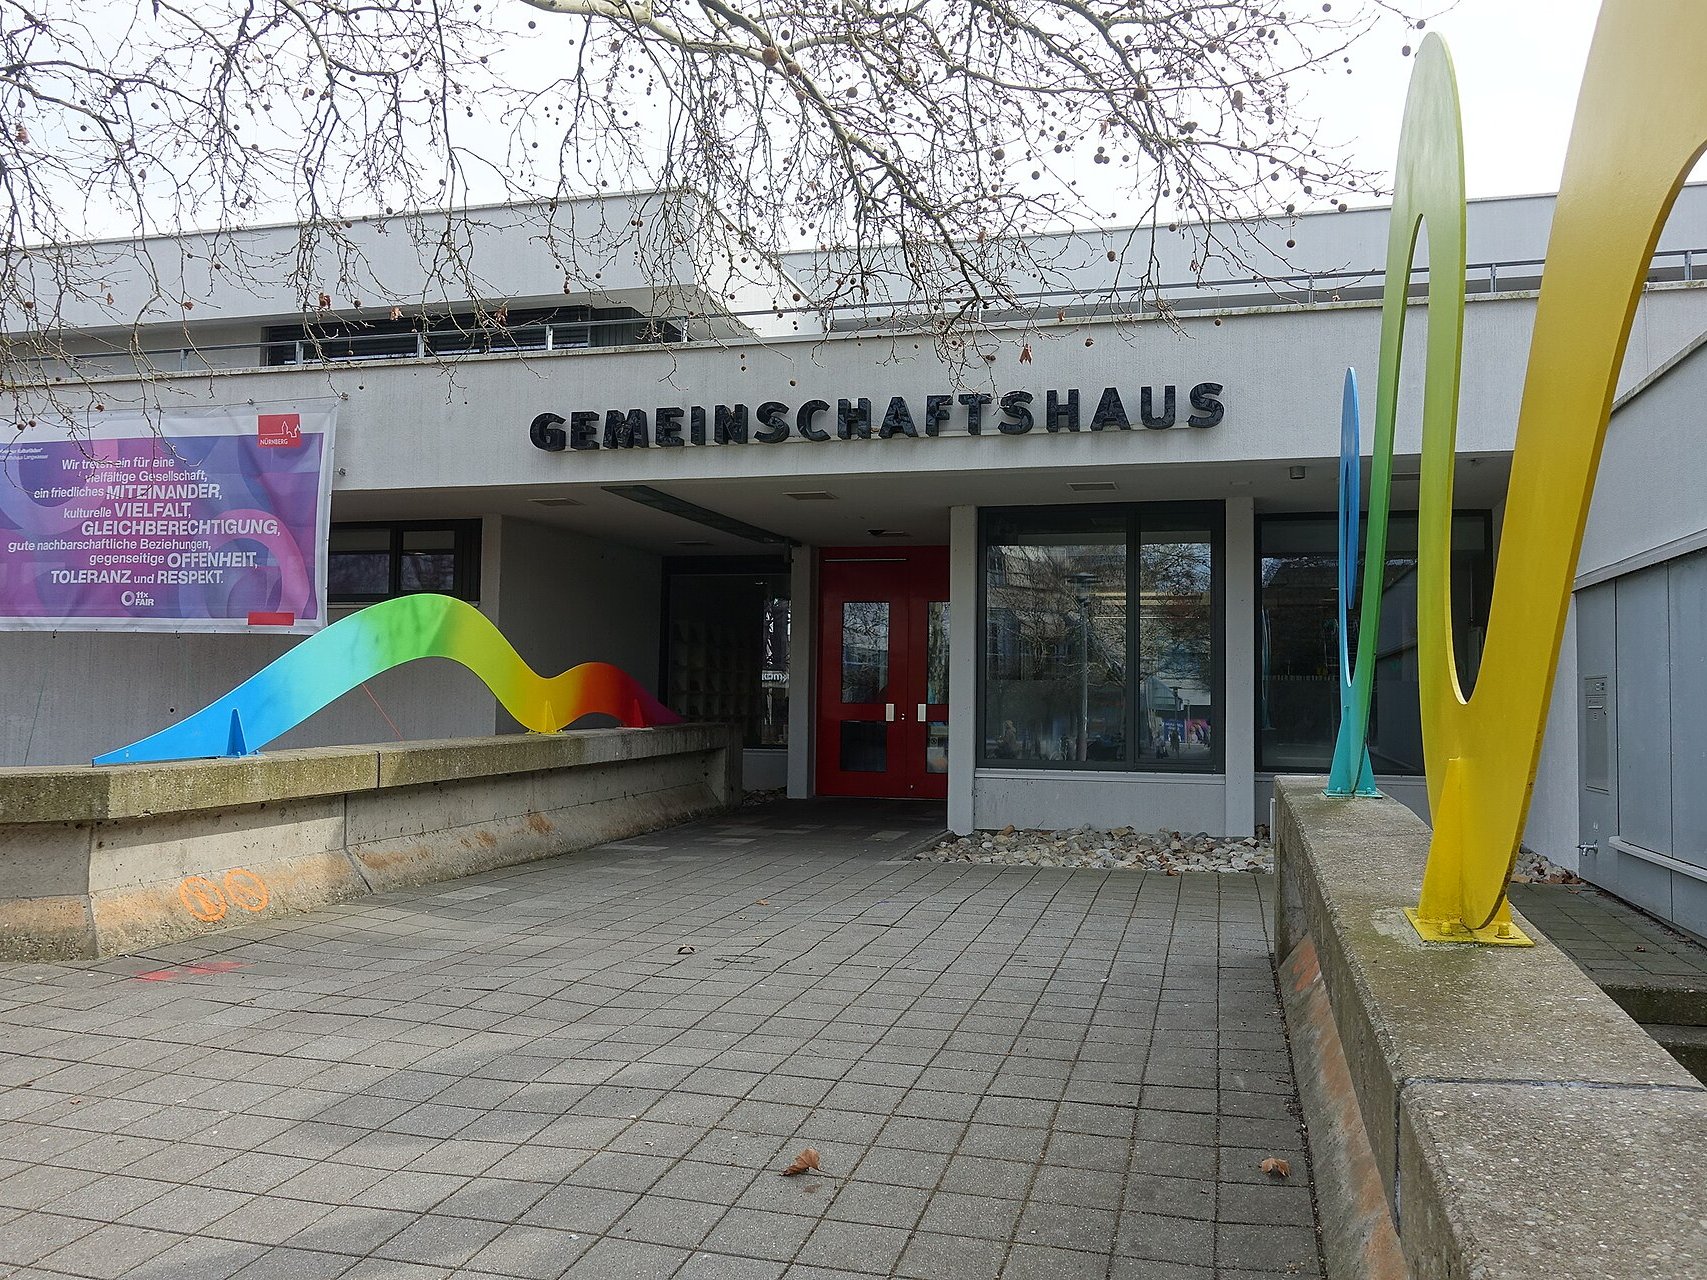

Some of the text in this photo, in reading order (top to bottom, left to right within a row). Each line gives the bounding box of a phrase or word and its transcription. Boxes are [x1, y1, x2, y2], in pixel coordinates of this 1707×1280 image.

[529, 382, 1225, 452] GEMEINSCHAFTSHAUS
[260, 438, 288, 446] NÜRNBERG
[62, 457, 175, 470] Wir treten ein für eine
[85, 470, 208, 484] vielfältige Gesellschaft,
[34, 483, 223, 500] ein friedliches MITEINANDER,
[63, 502, 191, 519] kulturelle VIELFALT,
[81, 519, 281, 537] GLEICHBERECHTIGUNG,
[8, 538, 211, 553] gute nachbarschaftliche Beziehungen,
[89, 552, 258, 569] gegenseitige OFFENHEIT,
[51, 570, 224, 584] TOLERANZ und RESPEKT.
[135, 598, 155, 606] FAIR
